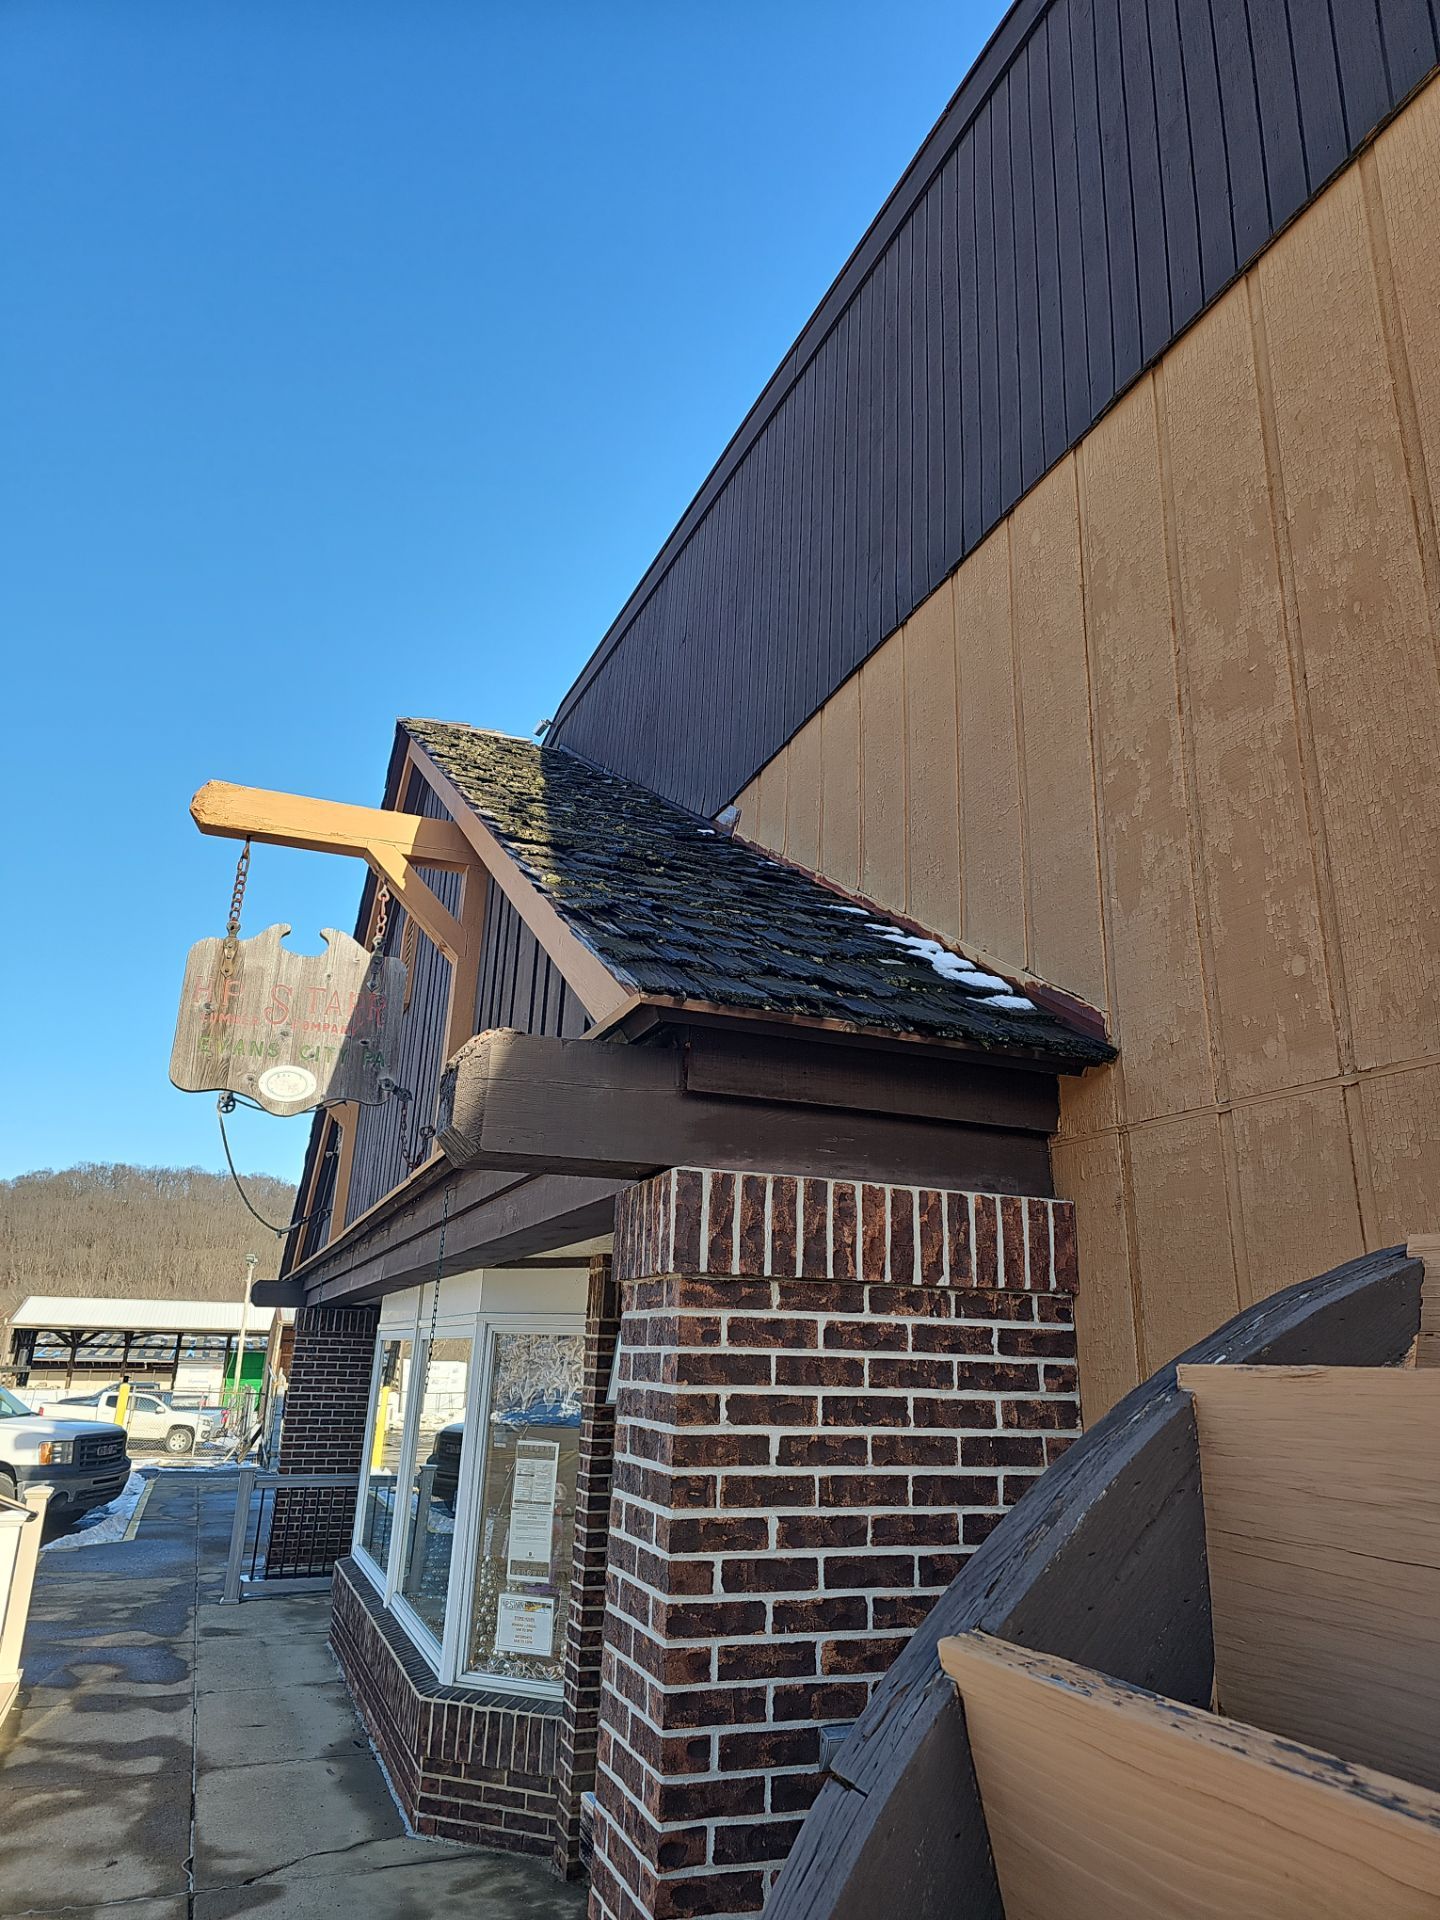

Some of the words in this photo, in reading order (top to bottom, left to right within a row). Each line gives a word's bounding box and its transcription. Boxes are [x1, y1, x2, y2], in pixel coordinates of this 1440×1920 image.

[263, 983, 387, 1027] STARR
[198, 1036, 280, 1058] EVANS
[299, 1044, 349, 1065] CITY
